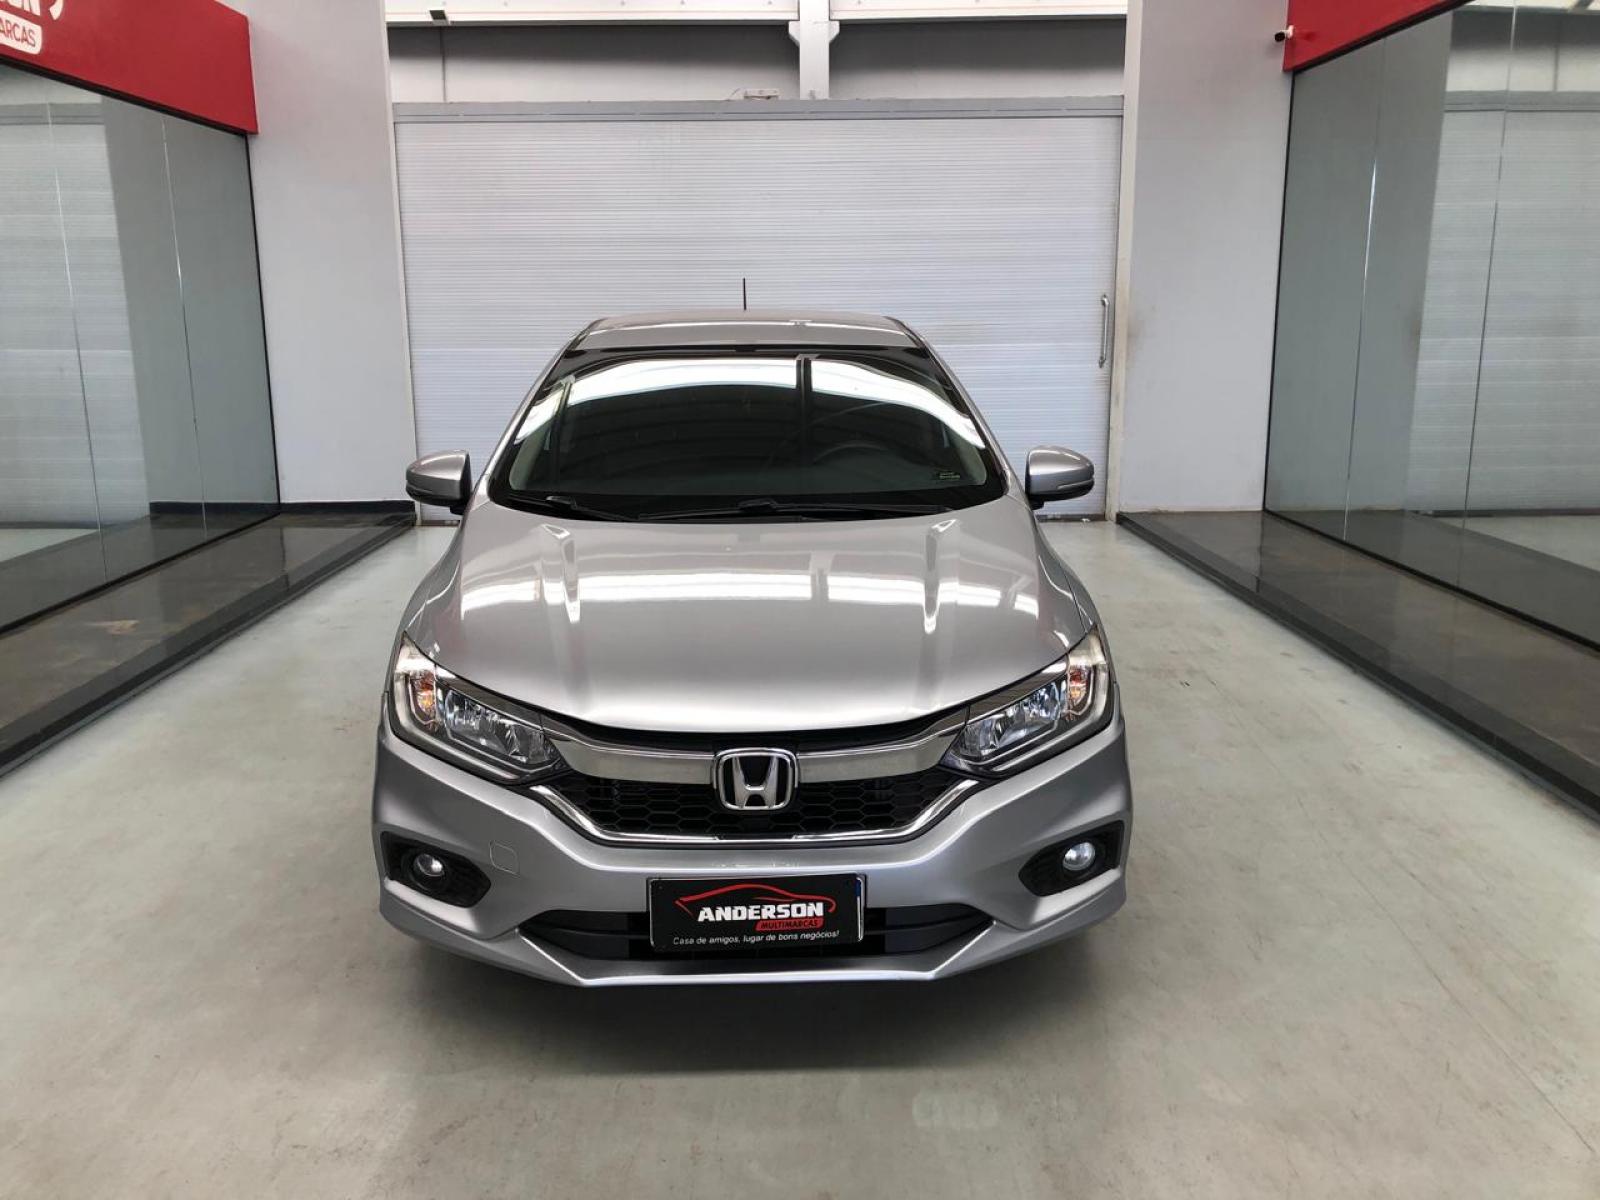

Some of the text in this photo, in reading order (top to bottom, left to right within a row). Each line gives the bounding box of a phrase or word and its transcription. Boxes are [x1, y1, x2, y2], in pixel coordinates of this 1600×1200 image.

[698, 902, 823, 921] ANDERSON
[760, 919, 819, 930] MULTIMARCAS
[673, 929, 840, 945] Casa de amigos, lugar de bons negócios!
